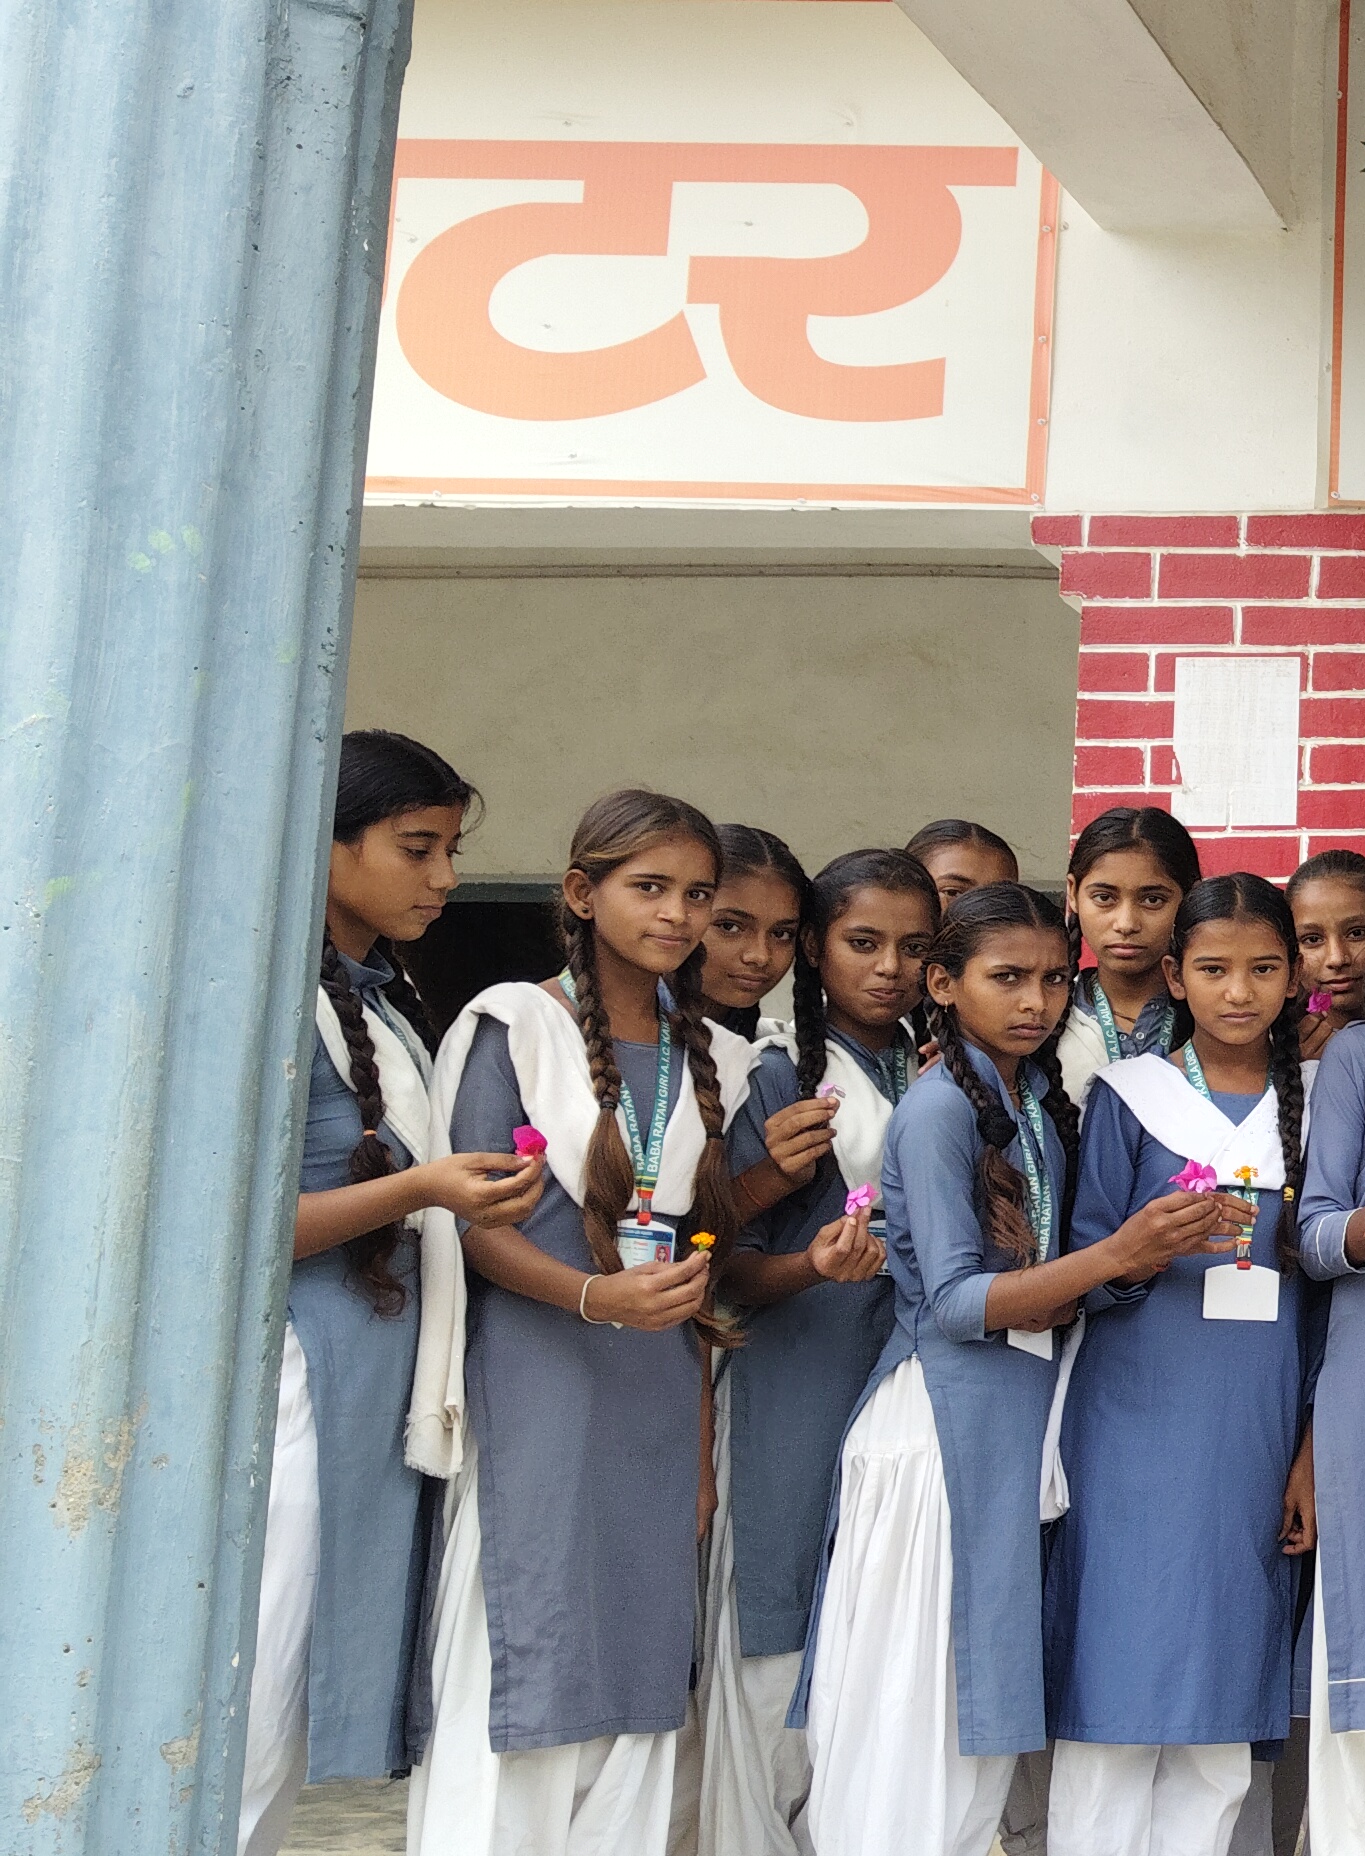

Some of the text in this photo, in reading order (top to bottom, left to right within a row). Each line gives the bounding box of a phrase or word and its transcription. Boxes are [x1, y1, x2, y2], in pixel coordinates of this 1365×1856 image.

[383, 139, 1019, 422] टर
[658, 1076, 669, 1098] GIRI
[620, 1090, 645, 1171] BABA RATAN
[653, 1100, 668, 1137] RATAN
[647, 1140, 662, 1173] BABA
[1041, 1185, 1052, 1225] RATAN
